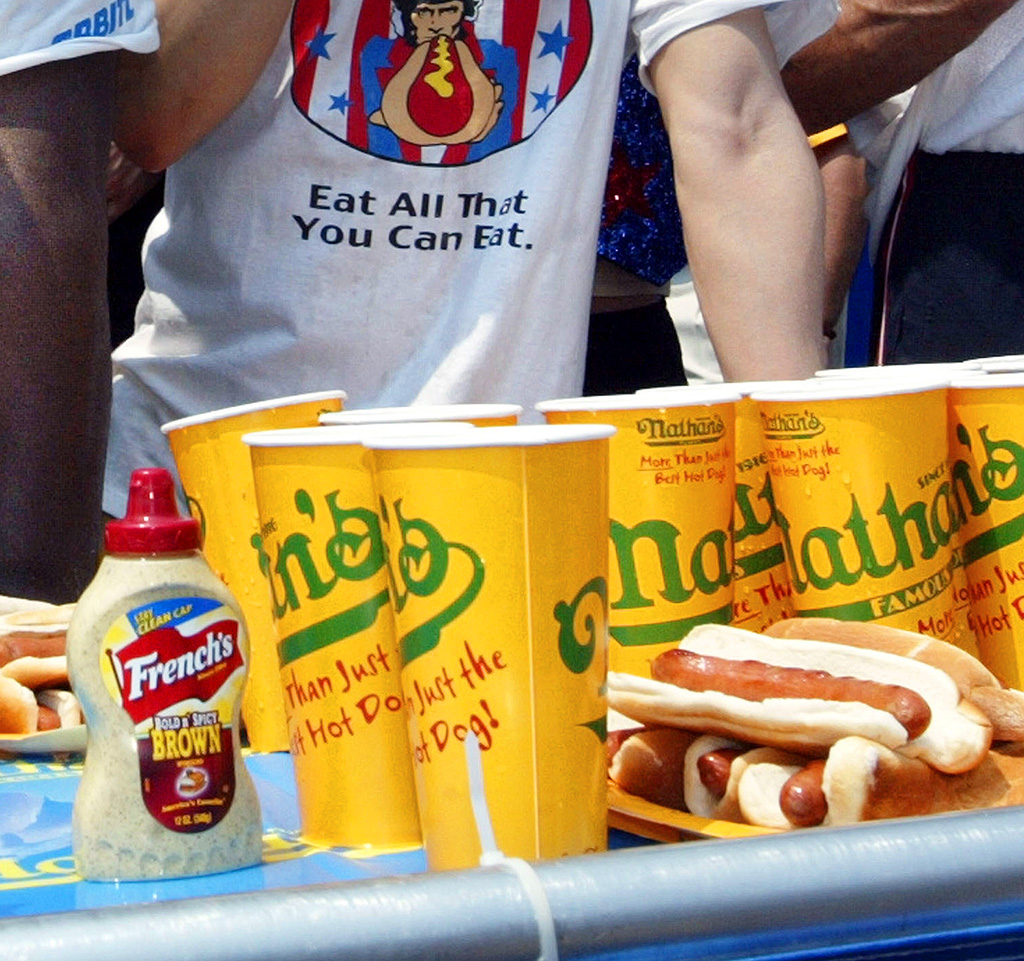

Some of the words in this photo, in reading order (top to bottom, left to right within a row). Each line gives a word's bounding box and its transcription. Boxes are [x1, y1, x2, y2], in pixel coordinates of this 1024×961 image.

[309, 184, 376, 216] Eat
[388, 192, 444, 218] All
[458, 190, 528, 218] That
[292, 214, 373, 248] You
[388, 225, 462, 251] Can
[474, 222, 533, 250] Eat.
[124, 631, 233, 701] French's
[335, 644, 390, 693] Just
[414, 667, 456, 716] Just
[460, 640, 507, 689] the
[192, 711, 218, 727] SPICY
[305, 706, 354, 748] Hot
[431, 699, 499, 752] Dog!
[150, 723, 222, 761] BROWN
